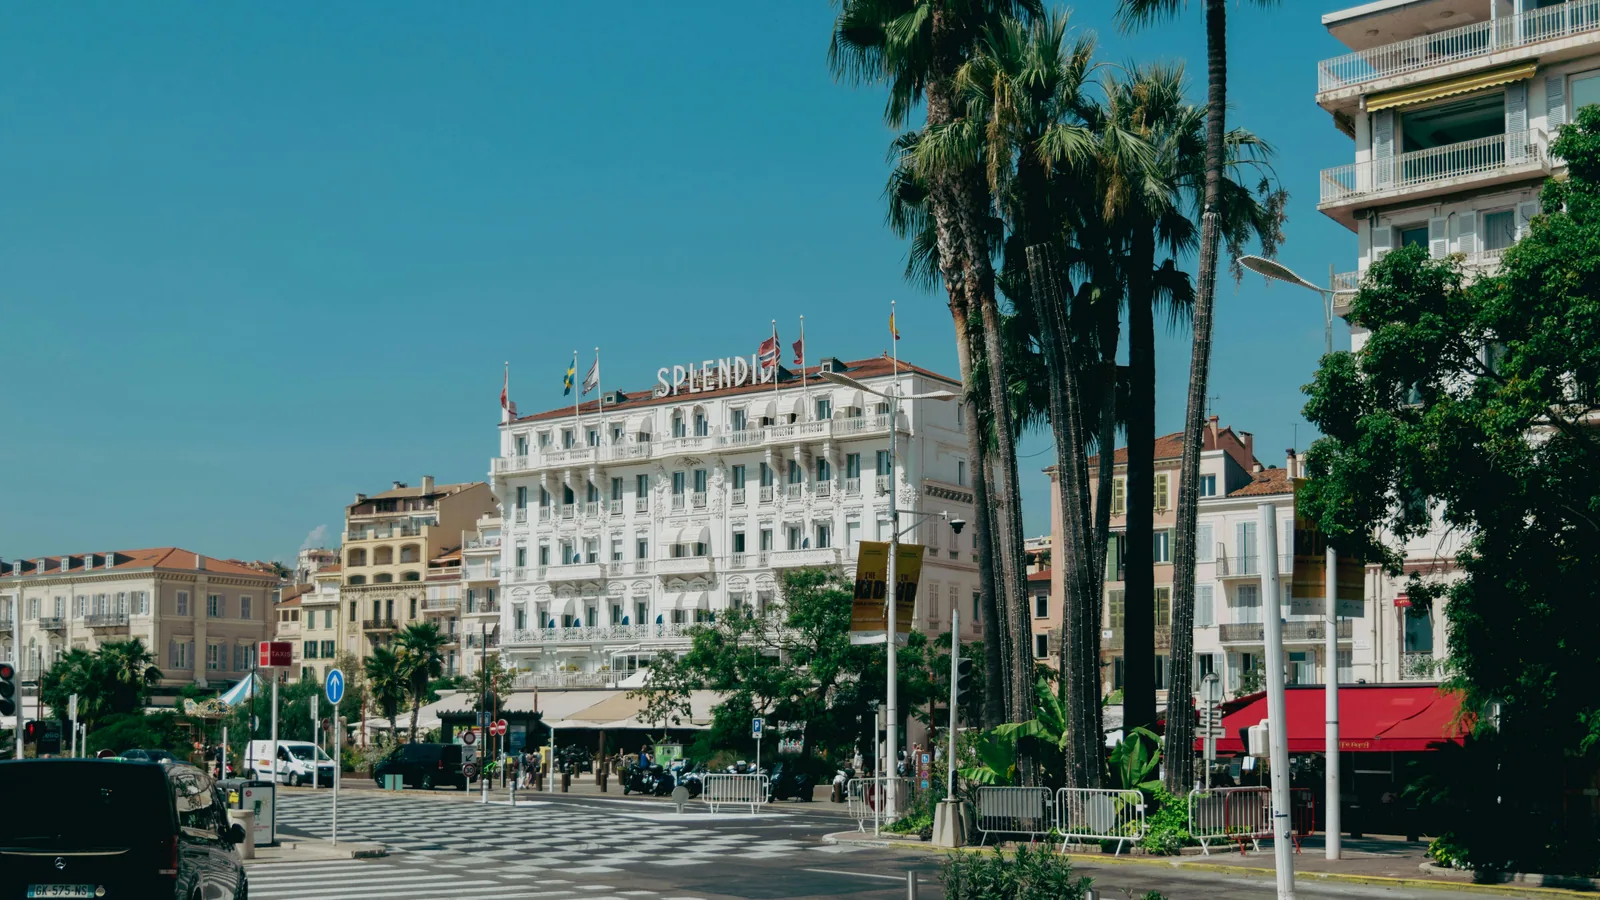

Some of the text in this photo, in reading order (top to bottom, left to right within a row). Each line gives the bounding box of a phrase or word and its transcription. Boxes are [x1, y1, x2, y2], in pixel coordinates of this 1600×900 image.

[271, 650, 291, 658] TAXIS
[754, 721, 759, 730] P
[35, 885, 88, 896] GK-575-NS
